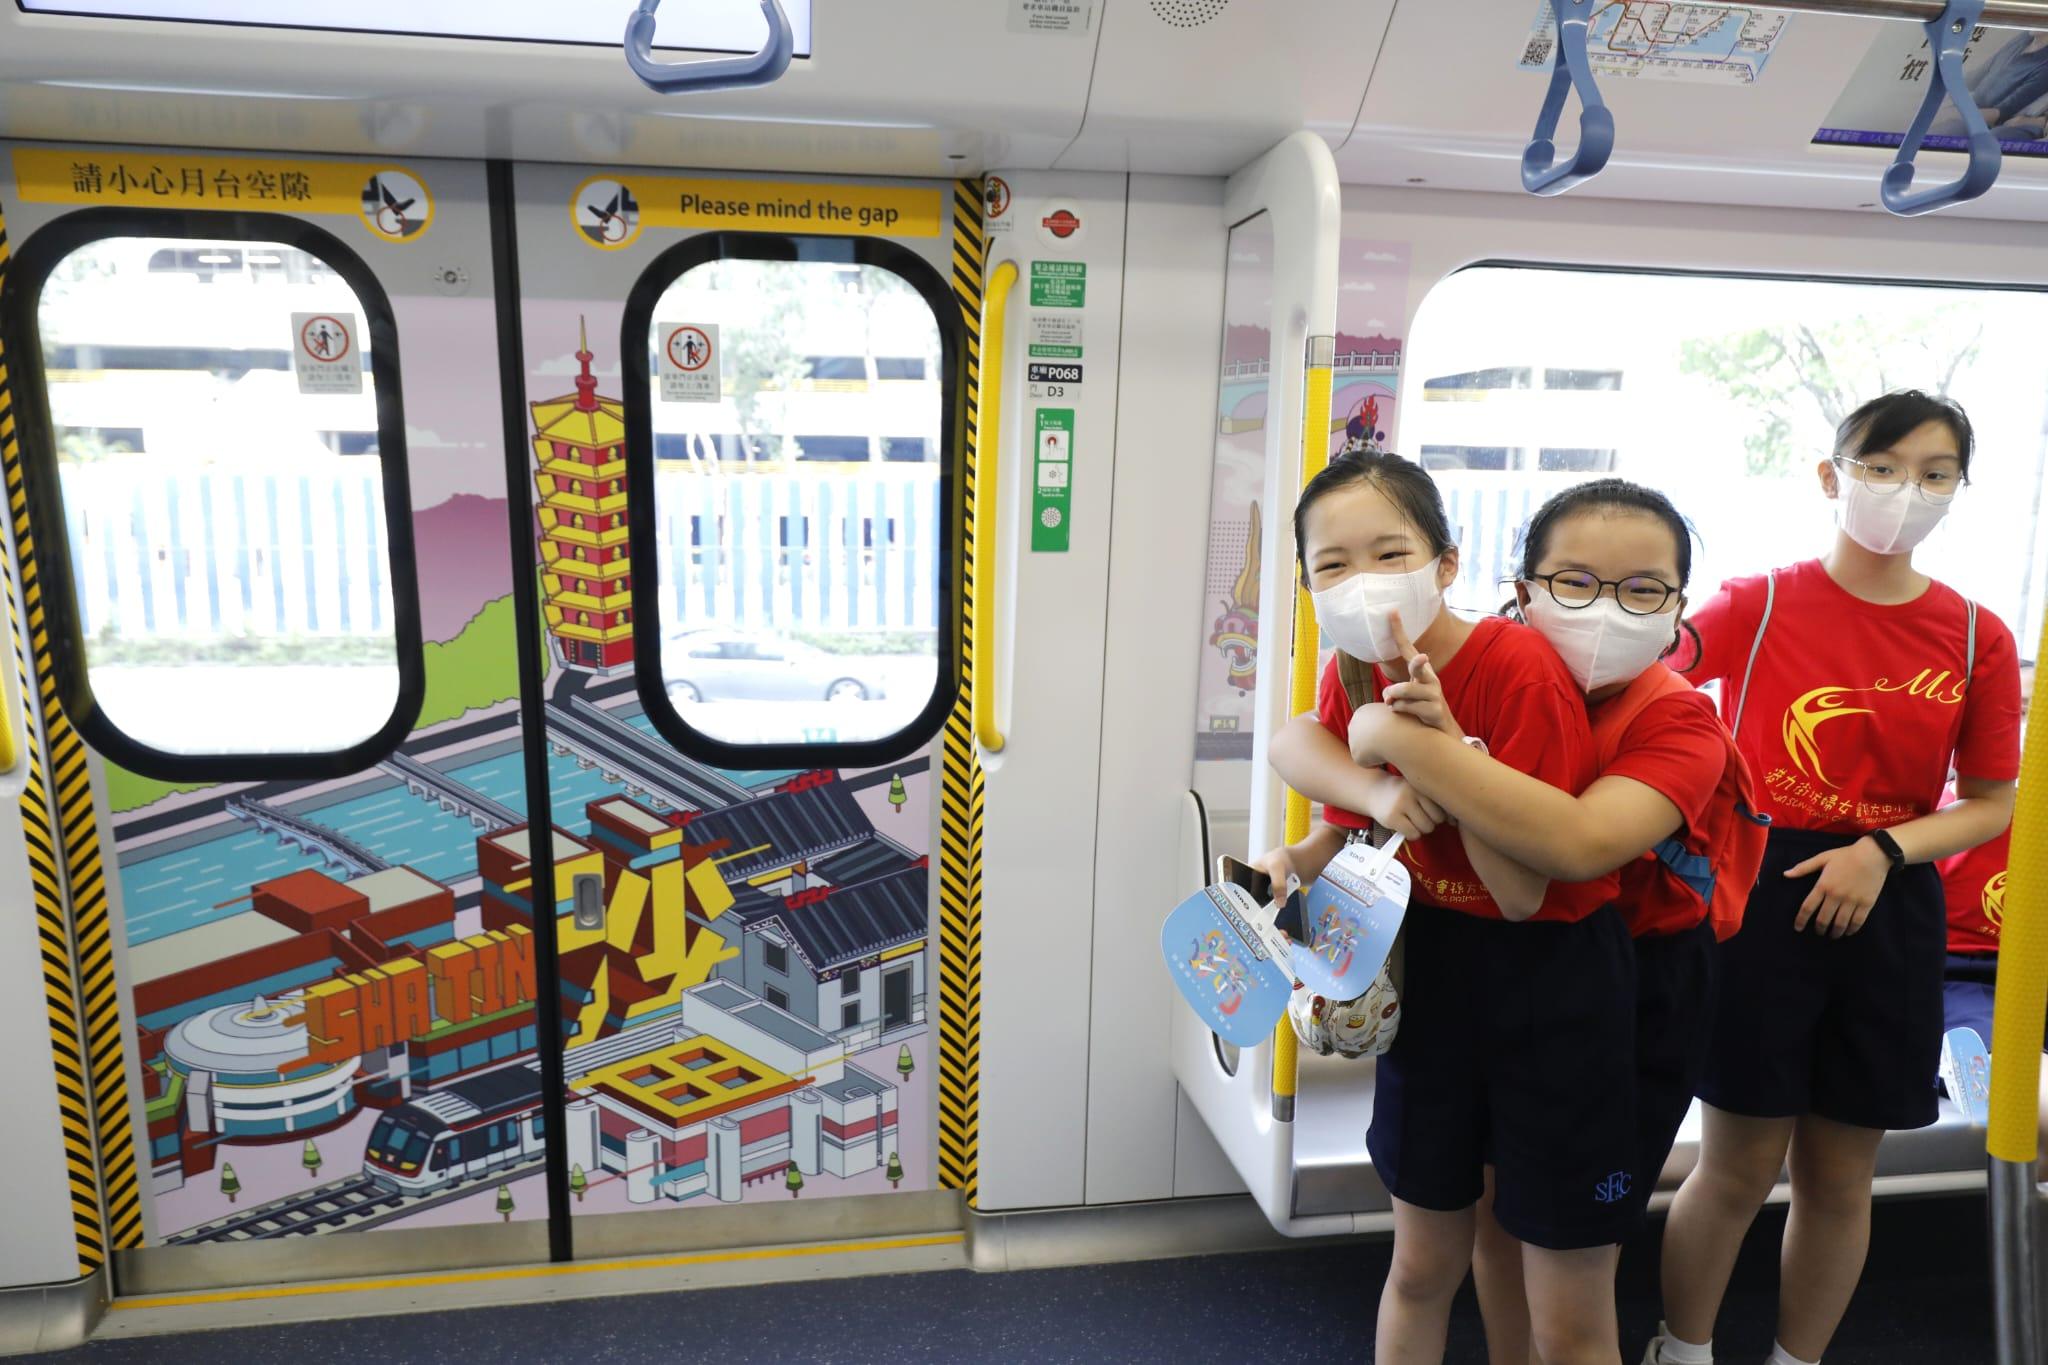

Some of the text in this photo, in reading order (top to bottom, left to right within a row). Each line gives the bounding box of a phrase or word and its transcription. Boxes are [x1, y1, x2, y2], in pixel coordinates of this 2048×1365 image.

[72, 161, 312, 202] 請小心月台空隙
[680, 194, 899, 227] Please mind the gap
[1048, 367, 1079, 380] P068
[1047, 386, 1064, 397] D3
[280, 923, 538, 1072] SHA TIN
